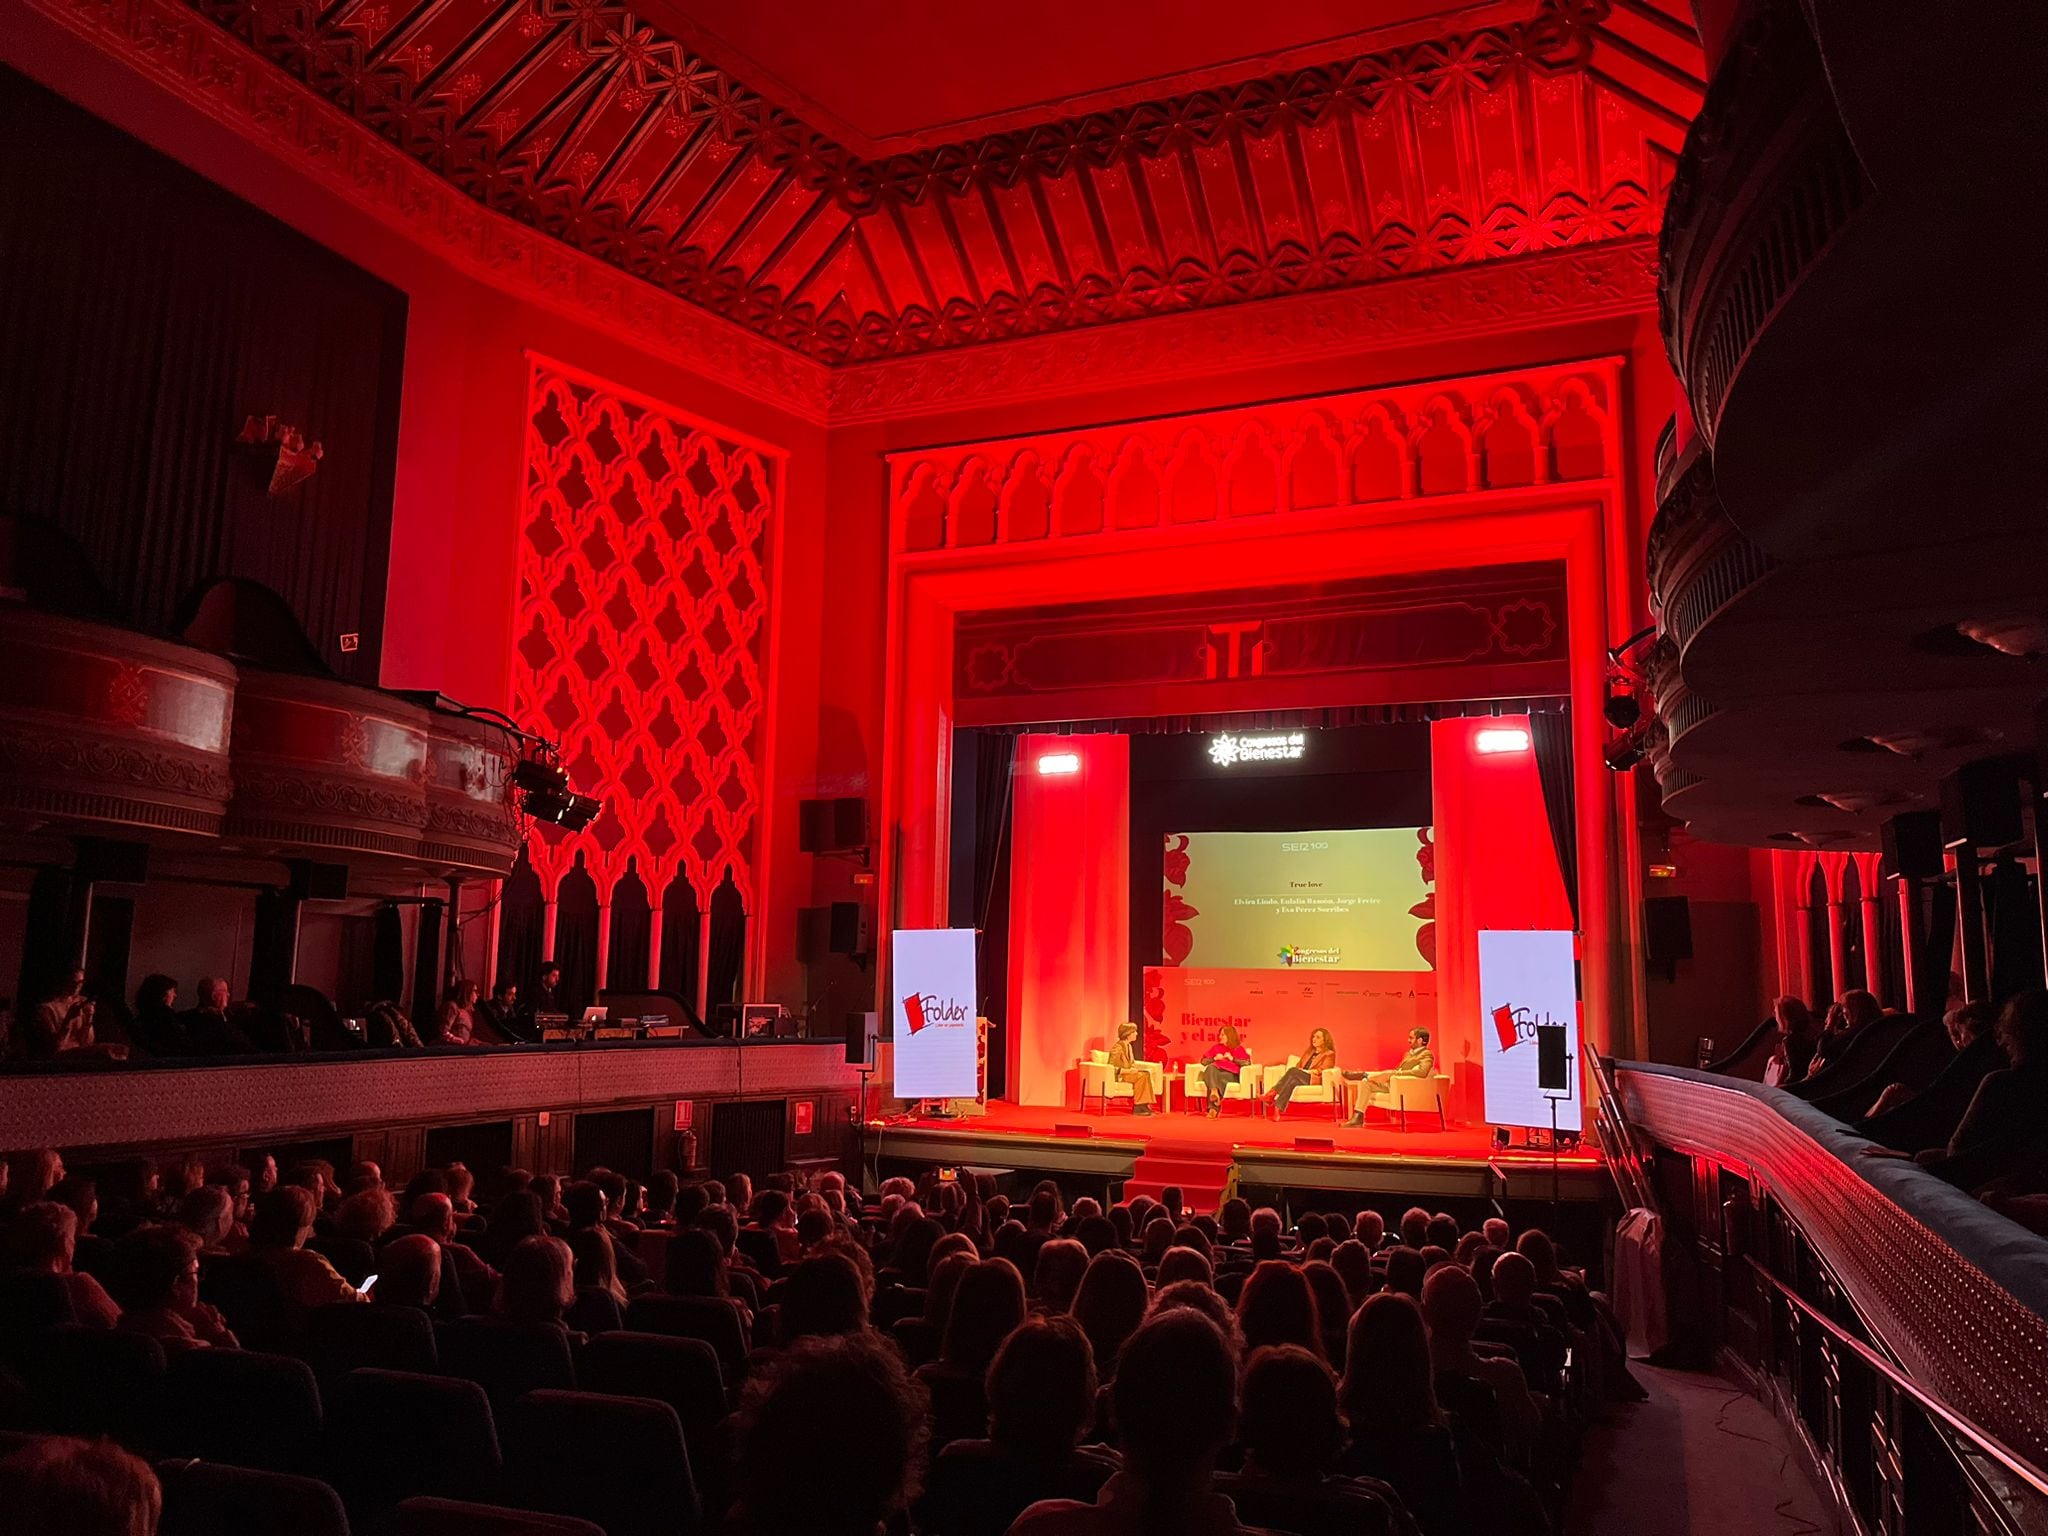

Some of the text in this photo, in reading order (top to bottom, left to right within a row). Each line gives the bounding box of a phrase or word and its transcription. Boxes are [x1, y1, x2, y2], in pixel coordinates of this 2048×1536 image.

[1239, 745, 1305, 761] Bienestar
[1328, 946, 1340, 954] del
[1292, 954, 1340, 963] Bienestar
[921, 995, 968, 1022] Folder
[1181, 1012, 1252, 1028] Bienestar
[1180, 1031, 1189, 1044] y
[1191, 1028, 1205, 1042] el
